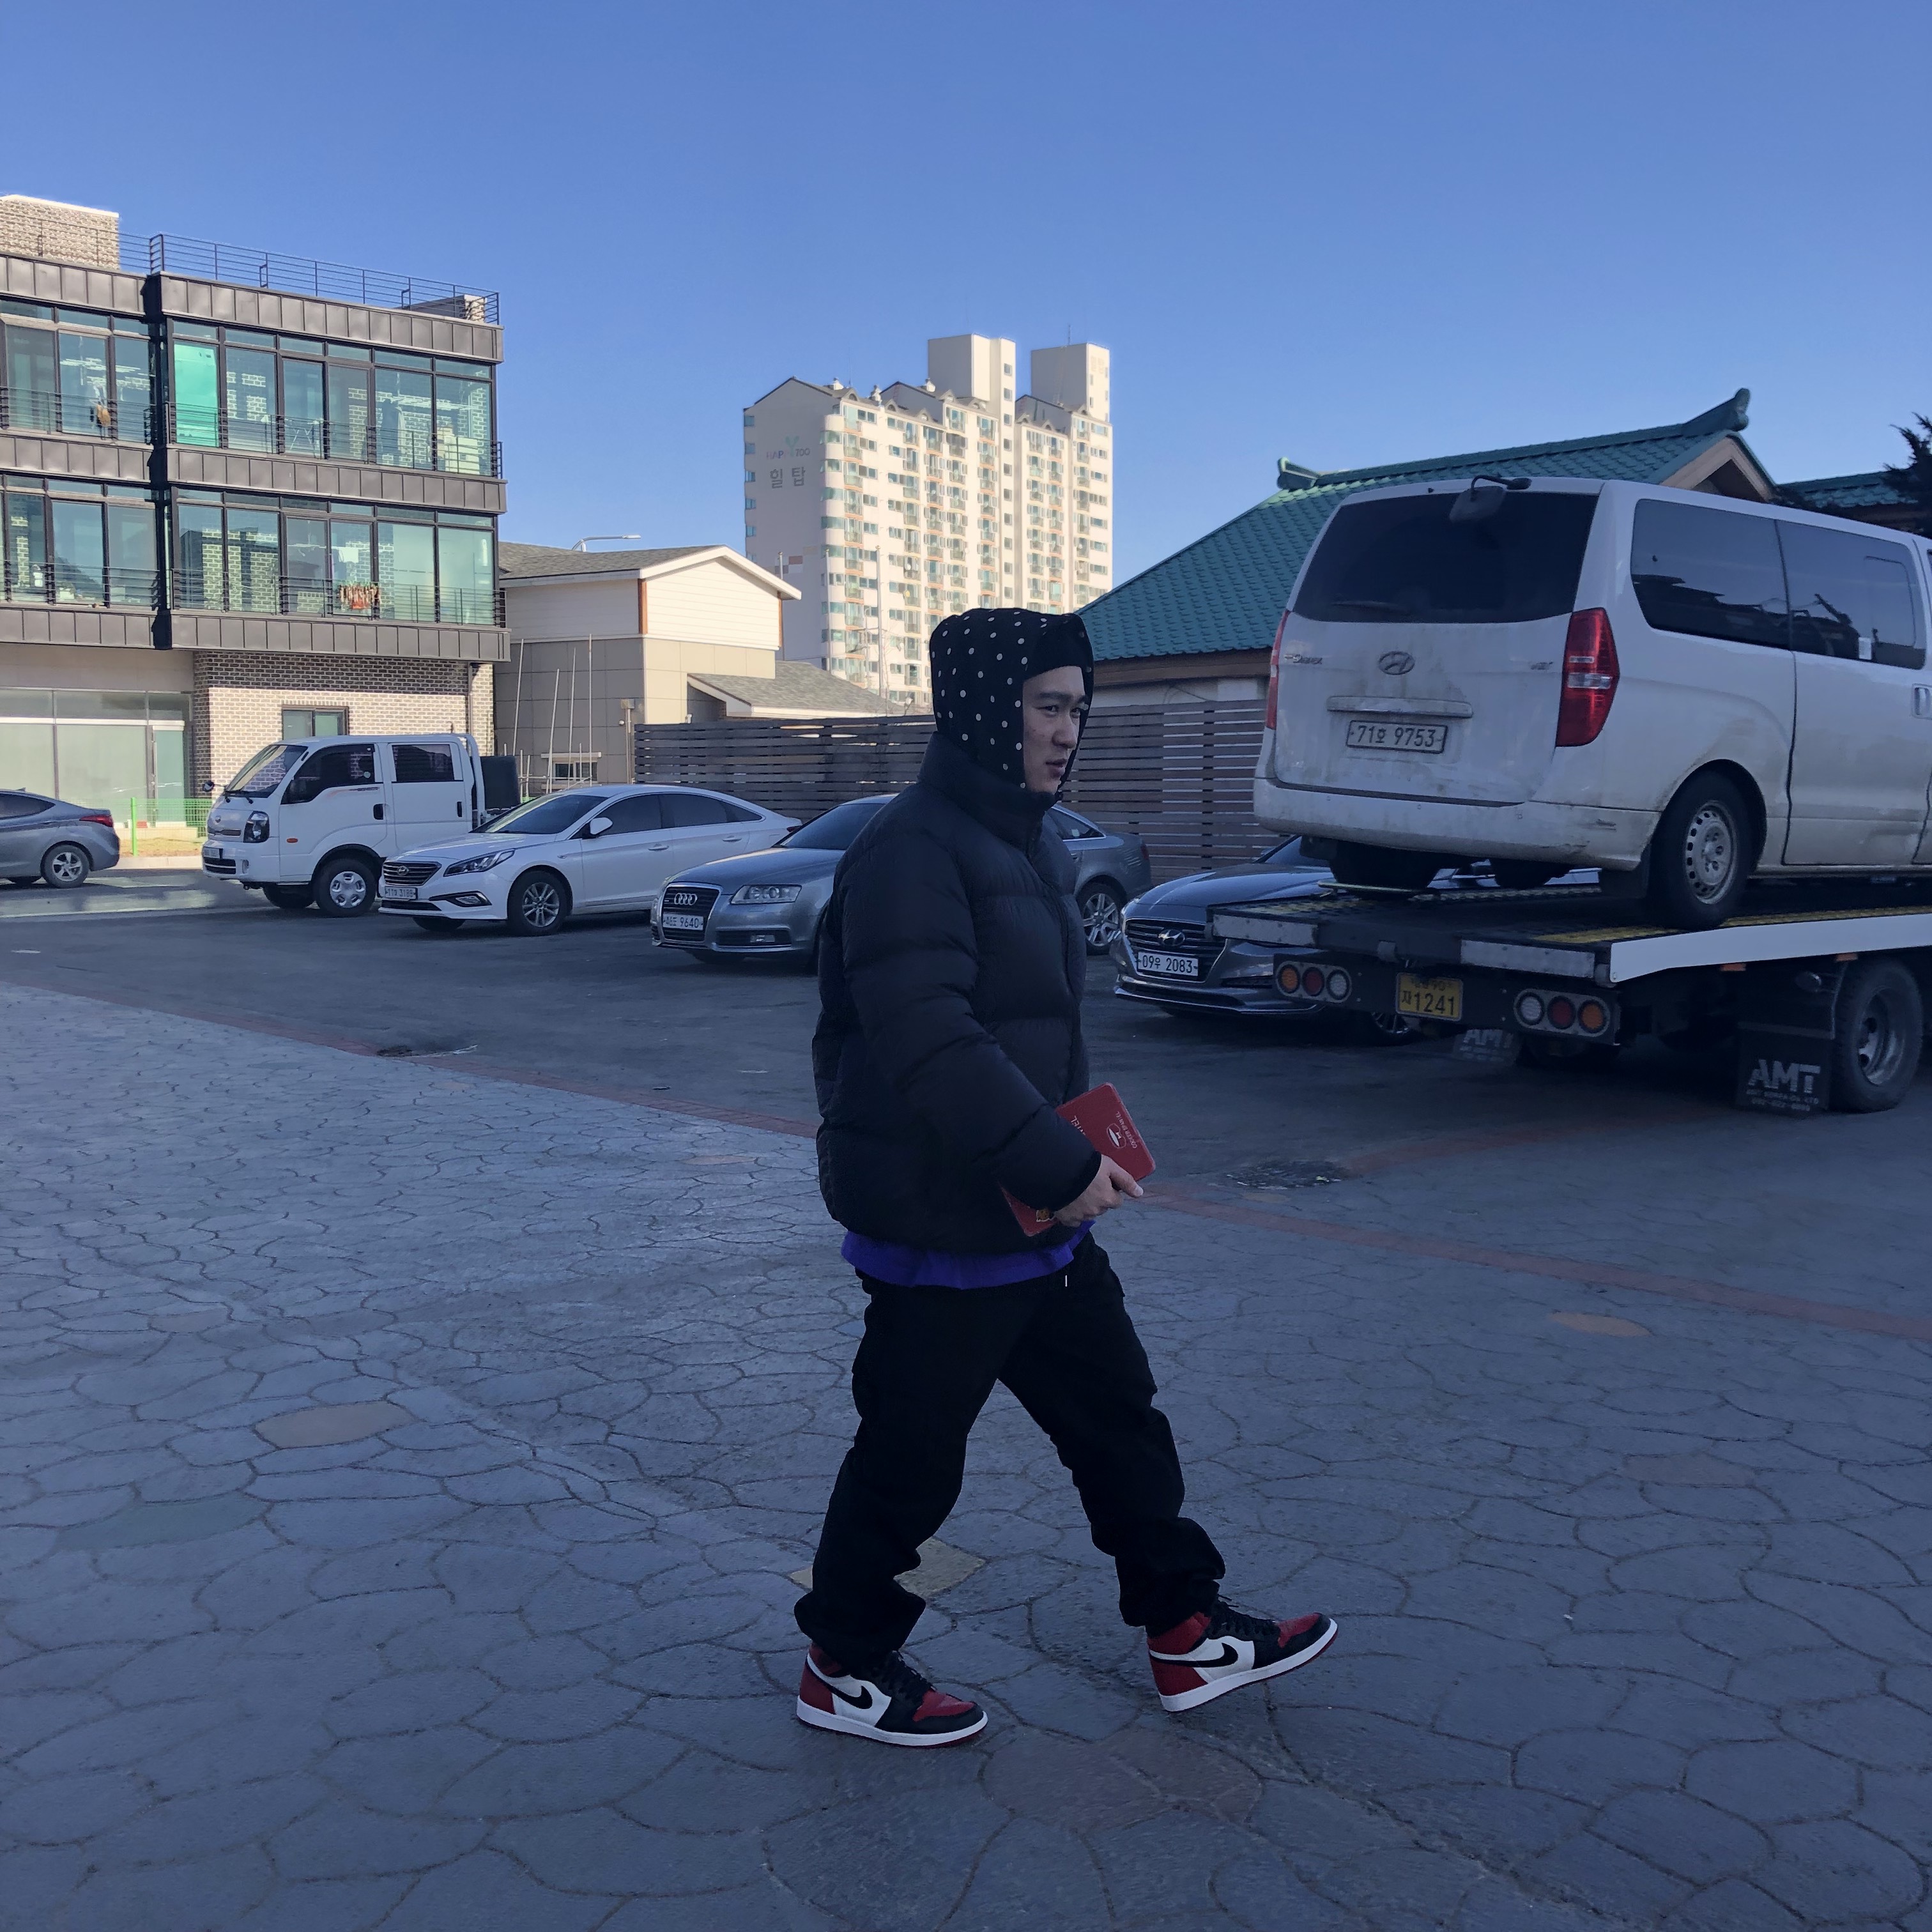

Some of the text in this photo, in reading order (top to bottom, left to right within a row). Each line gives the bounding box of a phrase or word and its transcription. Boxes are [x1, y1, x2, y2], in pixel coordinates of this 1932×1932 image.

[1358, 725, 1436, 747] 71호 9753
[1142, 954, 1193, 974] 09우 2083
[1747, 1059, 1820, 1094] AMT
